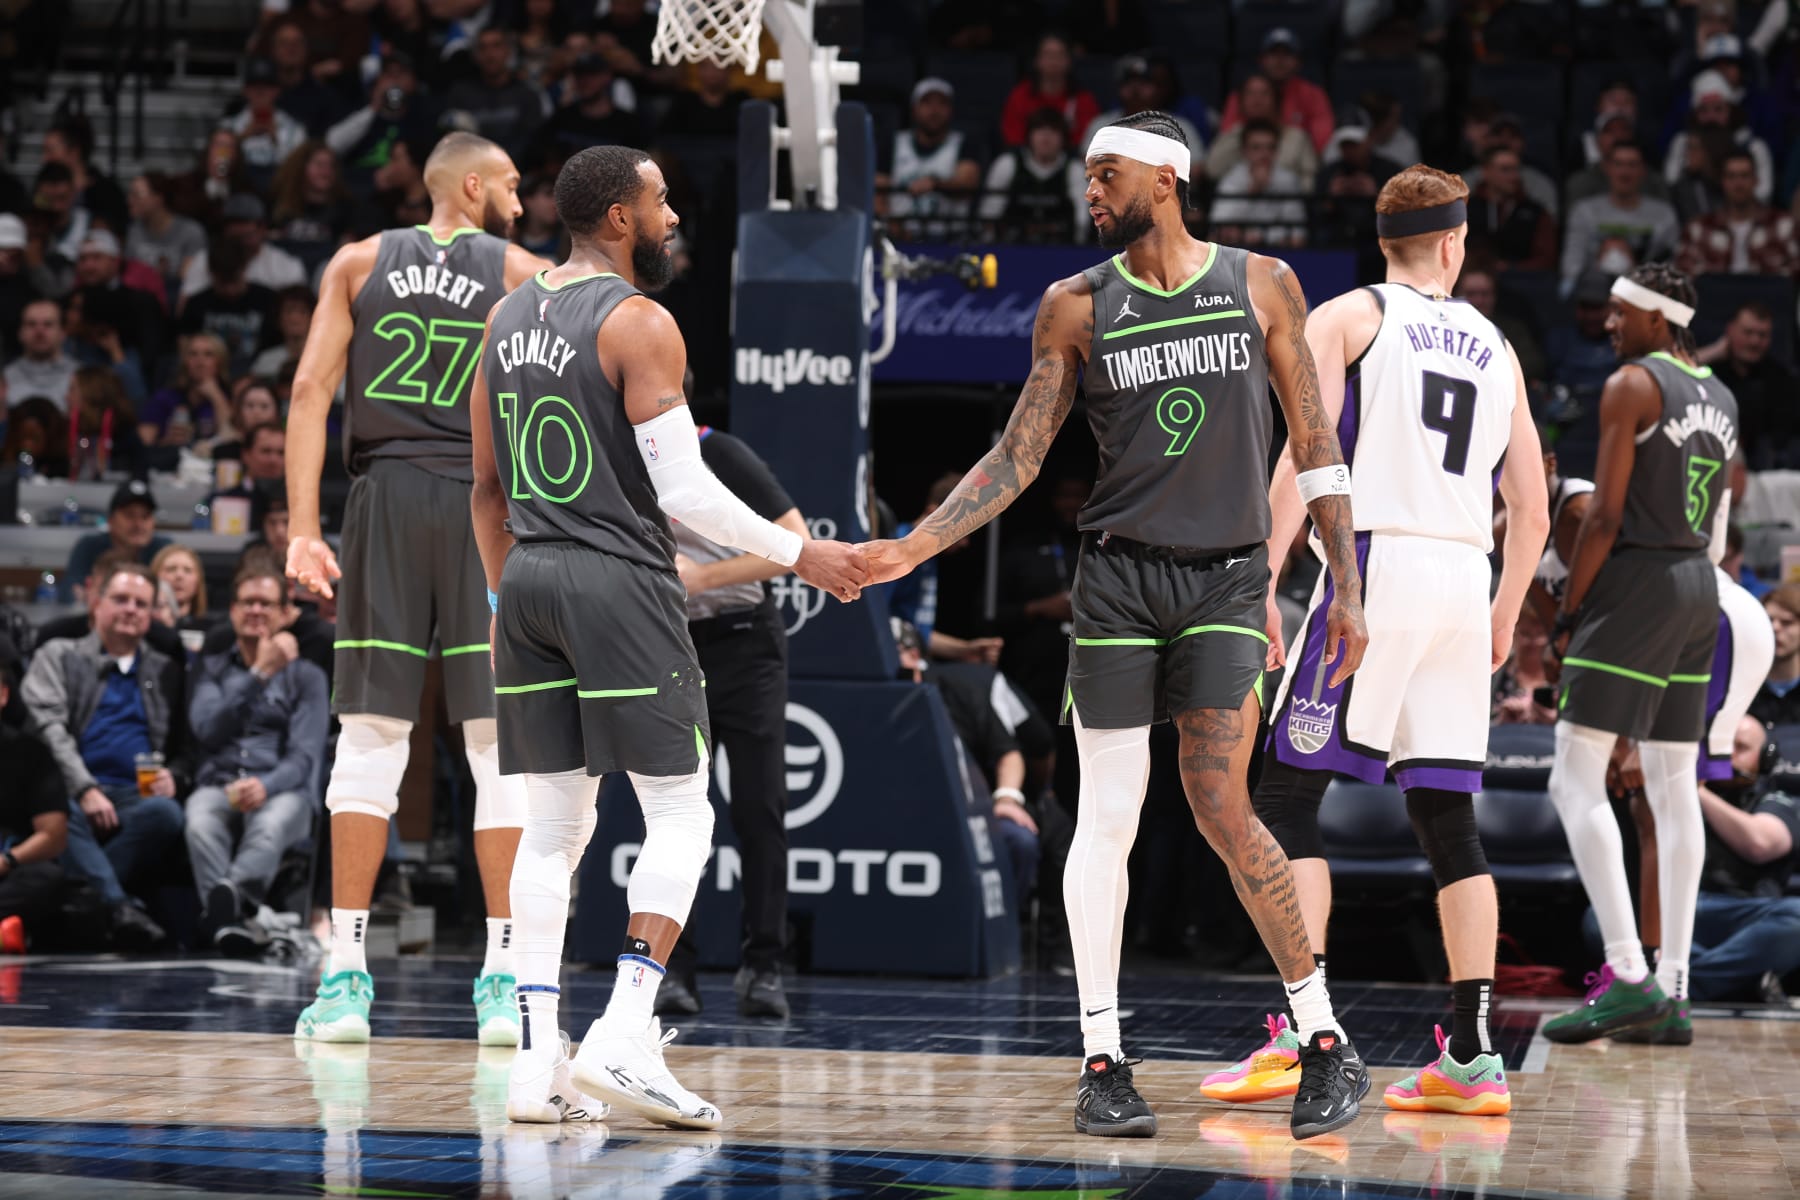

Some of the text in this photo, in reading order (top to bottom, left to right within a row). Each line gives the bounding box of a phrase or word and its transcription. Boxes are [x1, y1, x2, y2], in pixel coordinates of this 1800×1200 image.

[387, 265, 485, 309] GOBERT
[365, 312, 485, 407] 27
[497, 329, 576, 377] CONLEY
[1102, 333, 1251, 392] TIMBERWOLVES
[1404, 323, 1493, 370] HUERTER
[498, 393, 593, 503] 10
[1156, 387, 1205, 456] 9
[1421, 369, 1478, 477] 9
[1685, 455, 1722, 533] 3
[1290, 718, 1331, 736] KINGS
[611, 842, 942, 898] CMOTO
